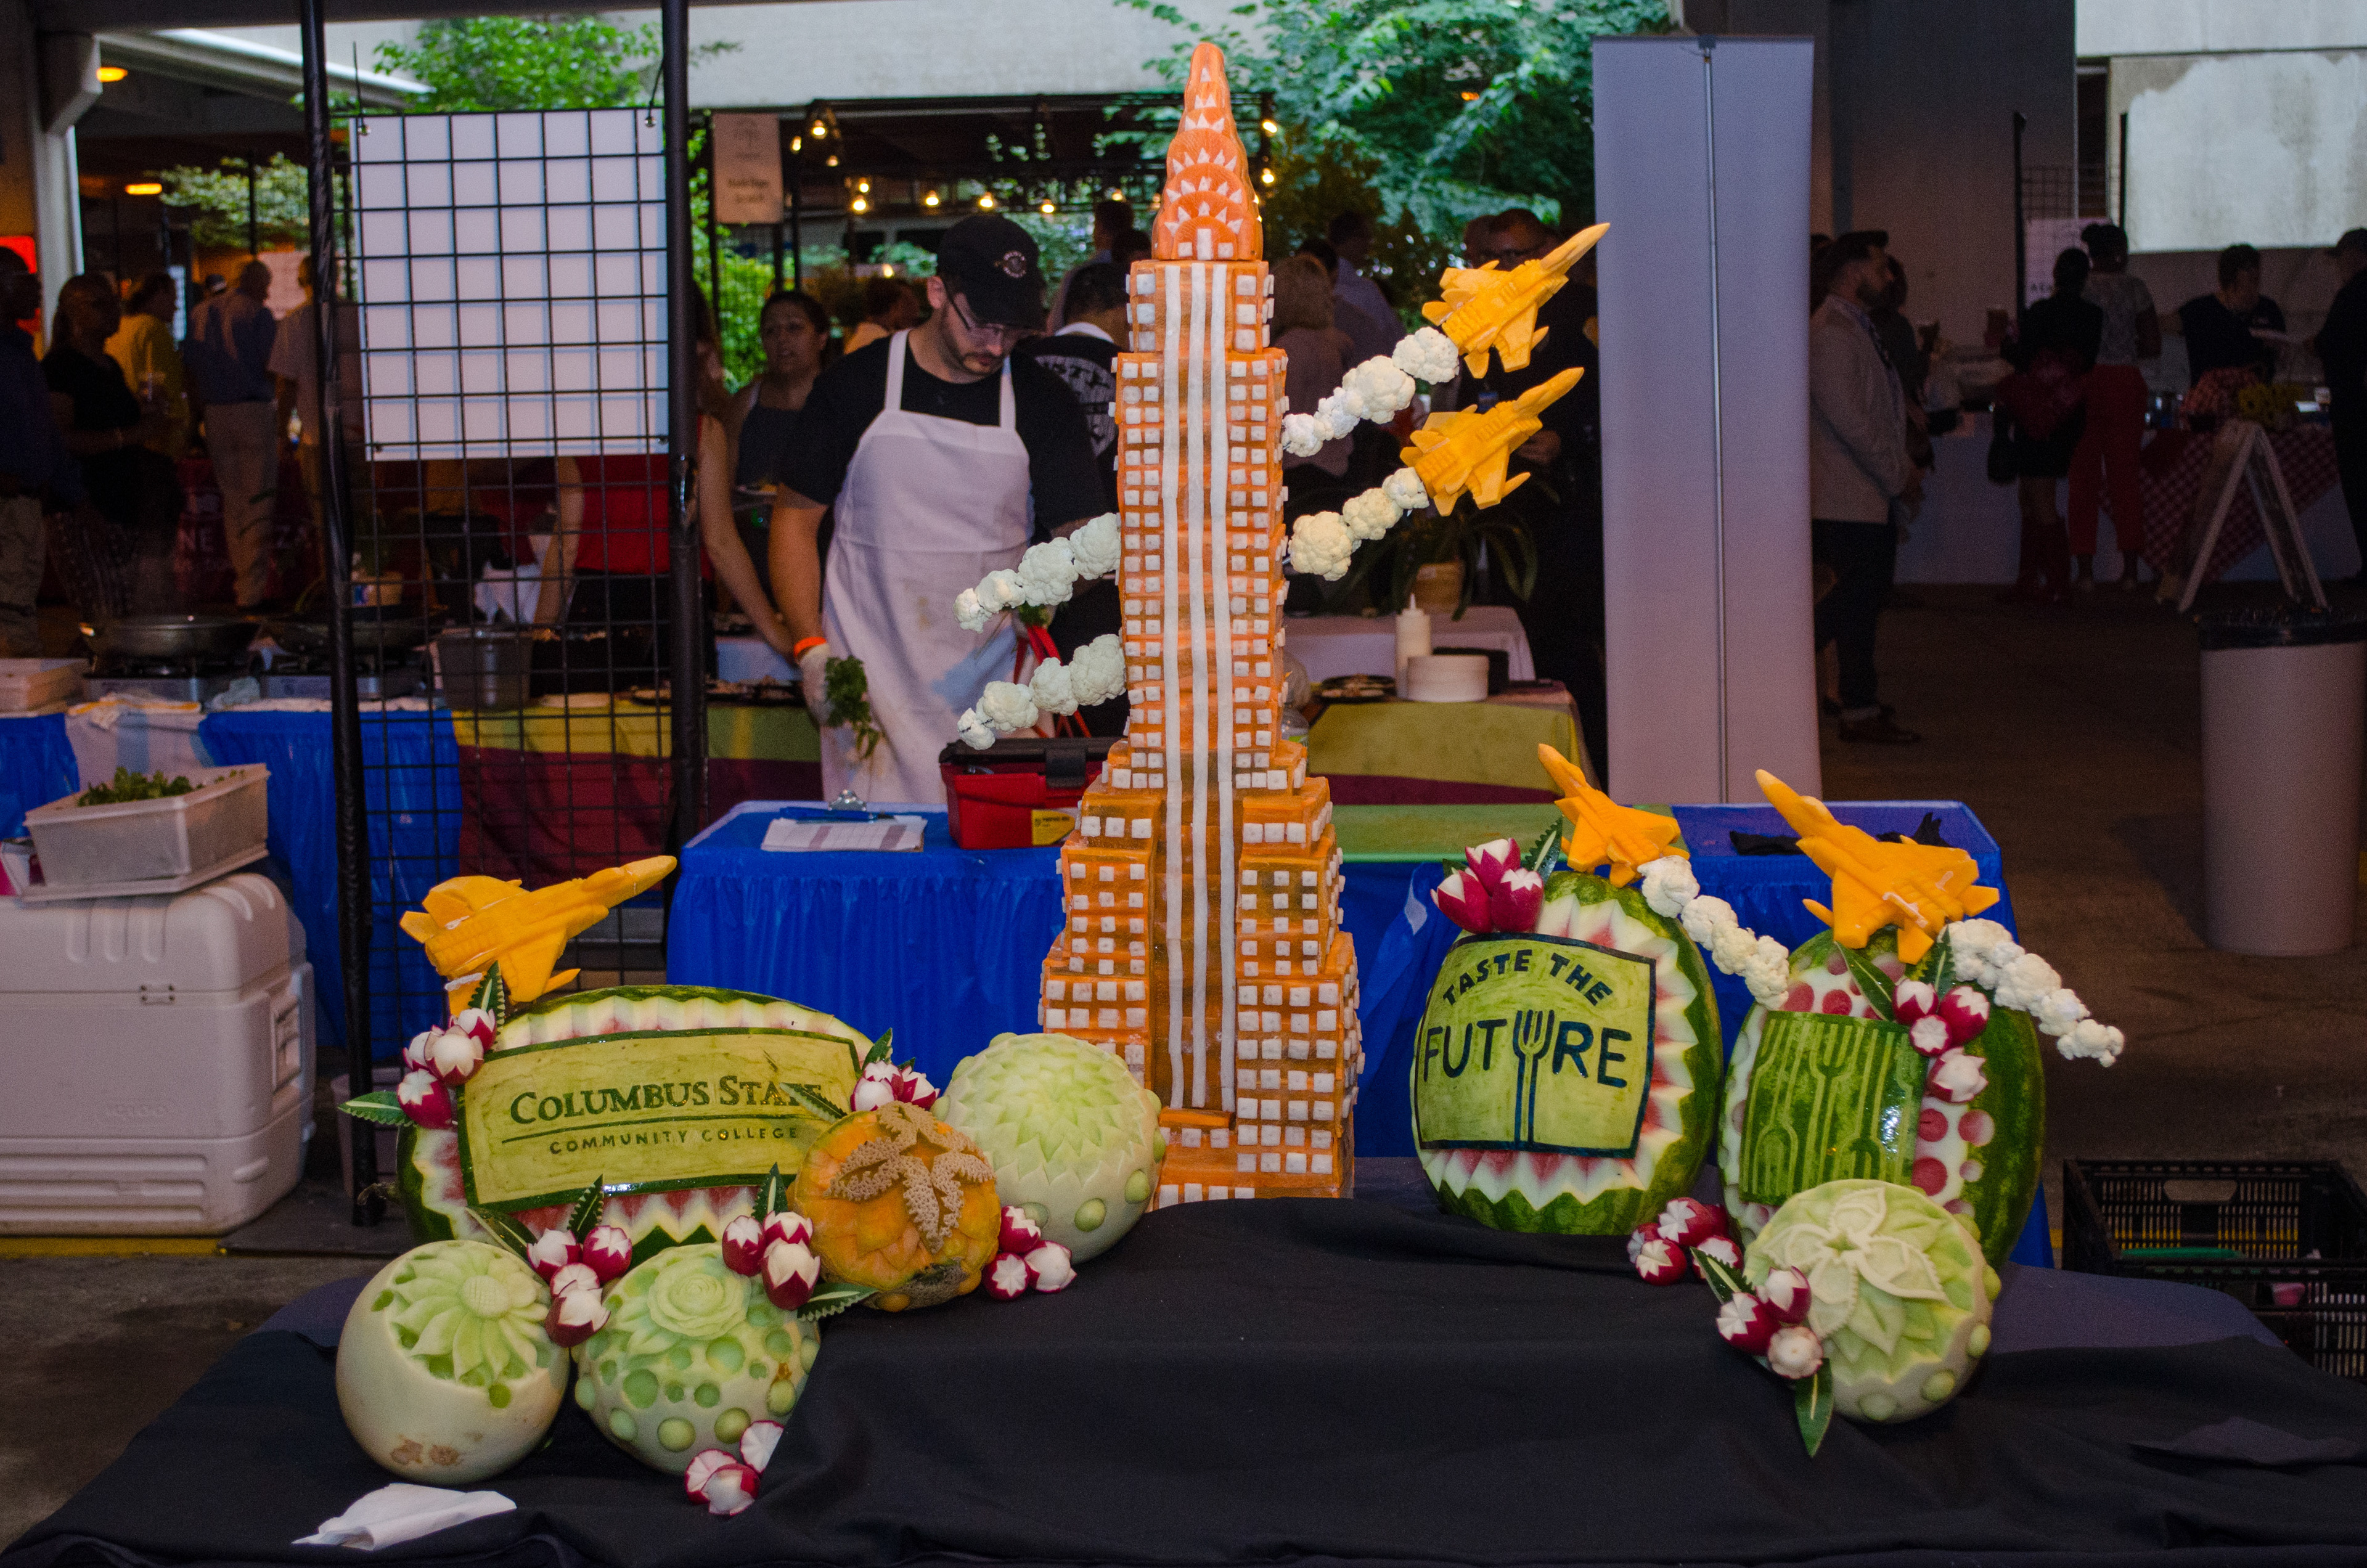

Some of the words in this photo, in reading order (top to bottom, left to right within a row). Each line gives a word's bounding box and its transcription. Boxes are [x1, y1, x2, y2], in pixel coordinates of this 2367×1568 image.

[1442, 949, 1532, 1006] TASTE
[1550, 952, 1614, 1007] THE
[1423, 1009, 1633, 1089] FUTURE
[510, 1080, 710, 1125] COLUMBUS
[549, 1130, 688, 1155] COMMUNITY
[701, 1127, 797, 1142] COLLEGE
